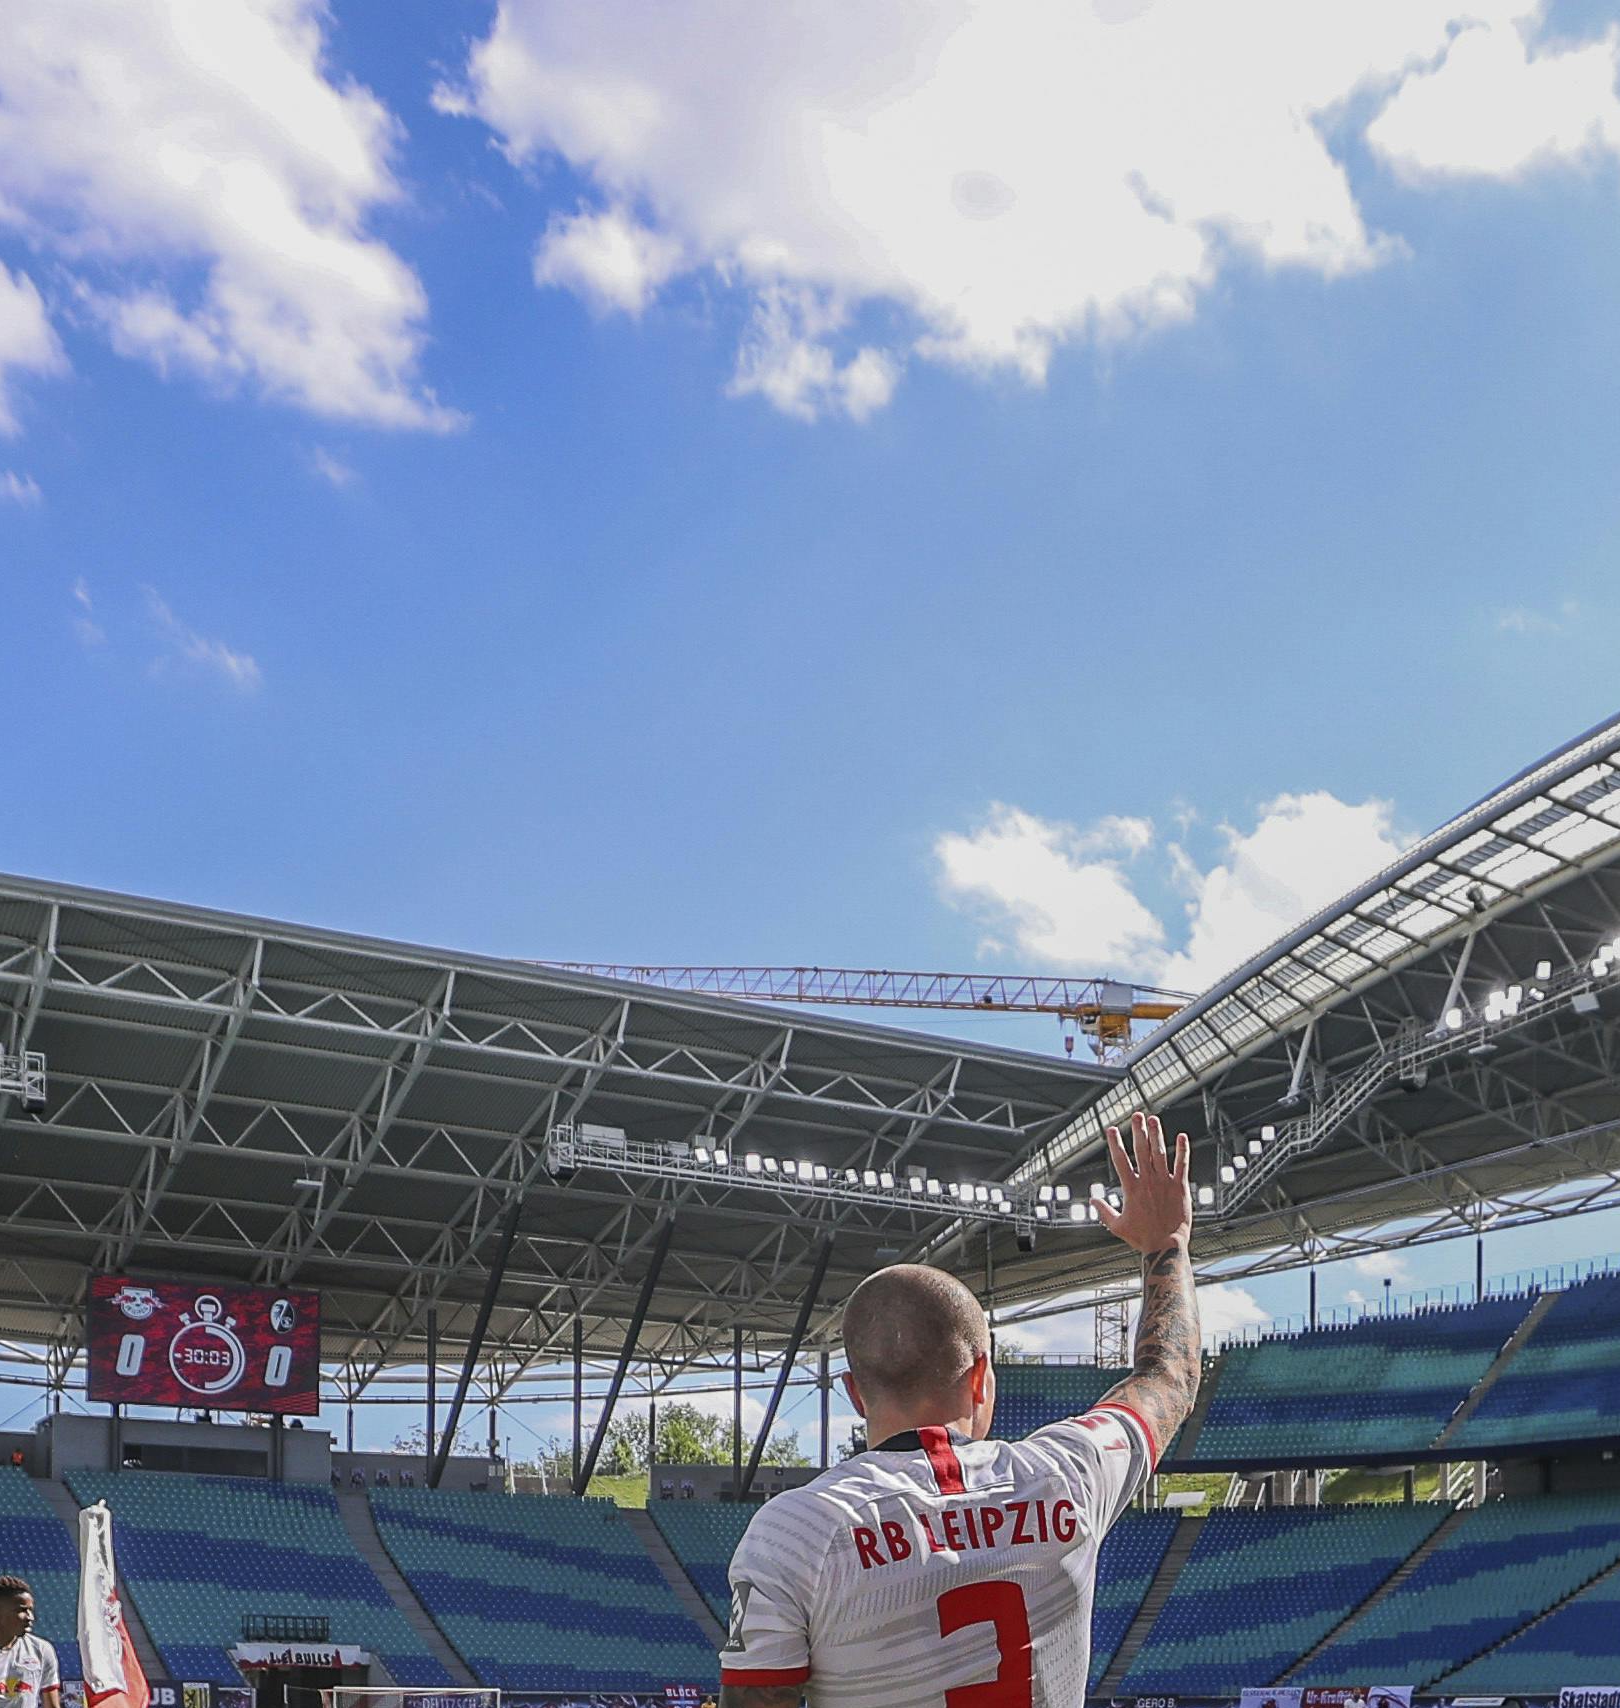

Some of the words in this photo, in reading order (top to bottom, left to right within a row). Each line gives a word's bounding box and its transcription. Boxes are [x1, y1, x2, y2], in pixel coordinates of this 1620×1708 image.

[116, 1334, 144, 1376] 0
[184, 1348, 229, 1366] 30:03
[265, 1345, 292, 1386] 0
[852, 1521, 912, 1569] RB
[918, 1499, 1077, 1553] LEIPZIG
[295, 1652, 330, 1665] BULLS
[666, 1688, 698, 1697] BLOCK
